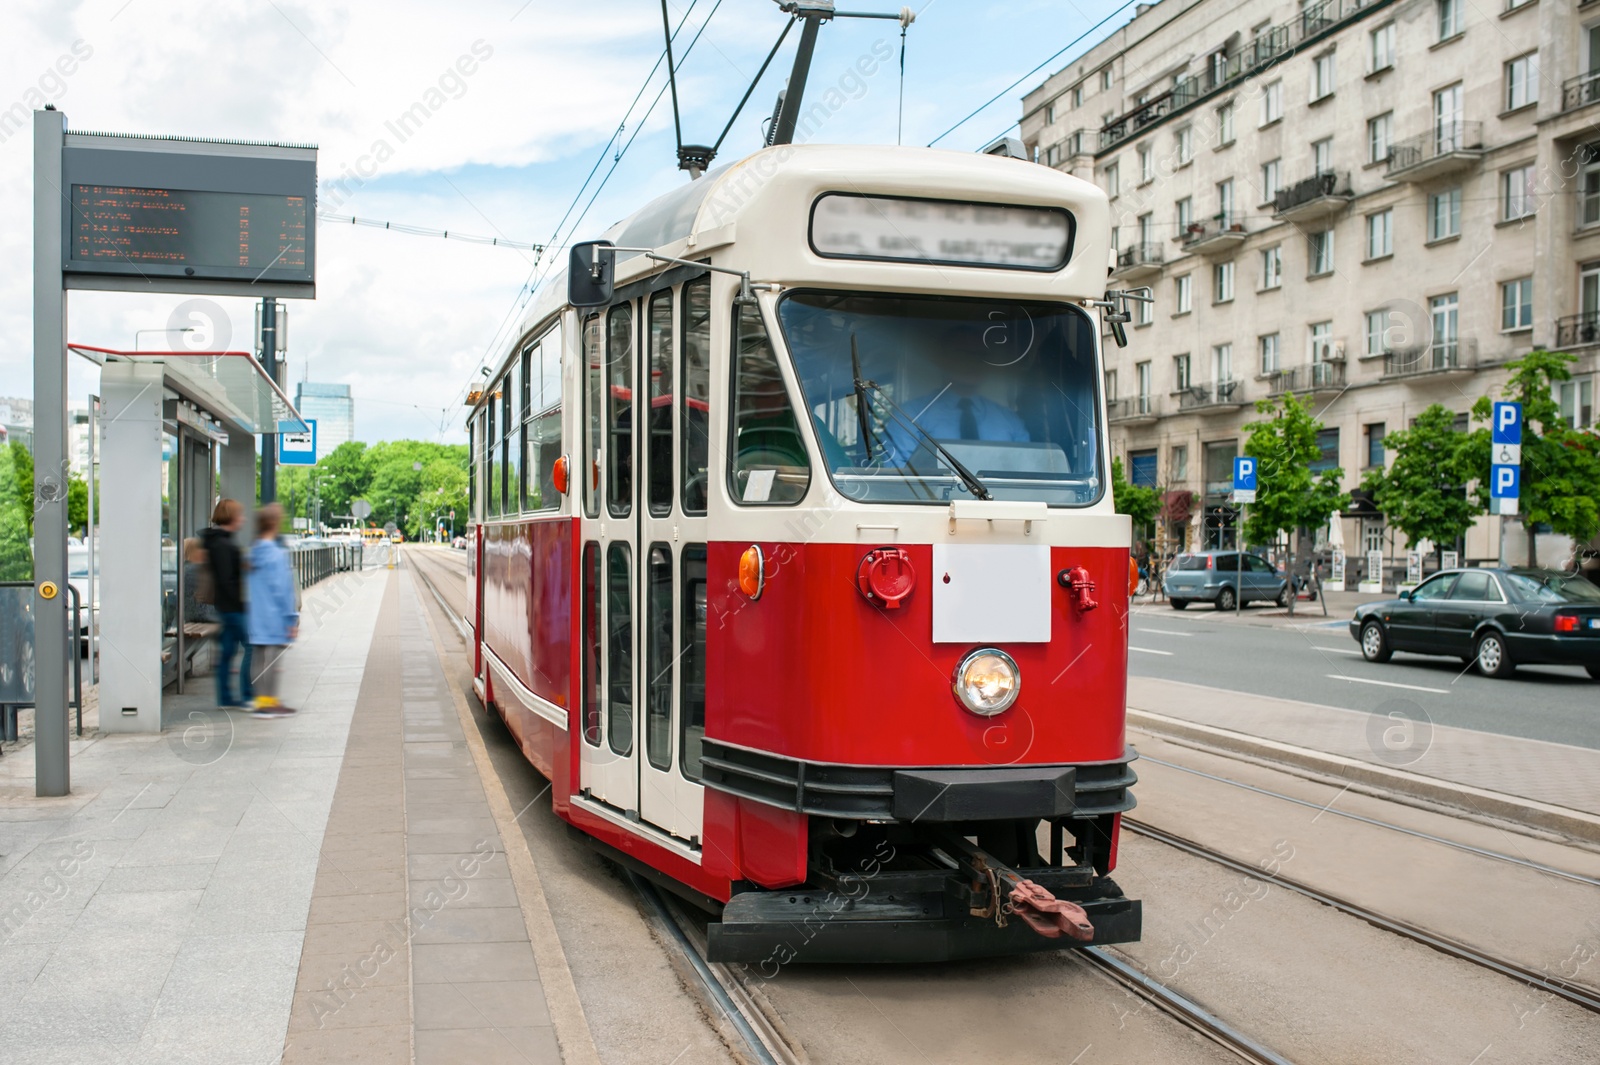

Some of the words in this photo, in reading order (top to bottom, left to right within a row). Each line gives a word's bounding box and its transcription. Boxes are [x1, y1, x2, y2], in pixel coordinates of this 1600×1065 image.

[1499, 405, 1516, 432] P
[1239, 460, 1252, 480] P
[1497, 467, 1514, 494] P
